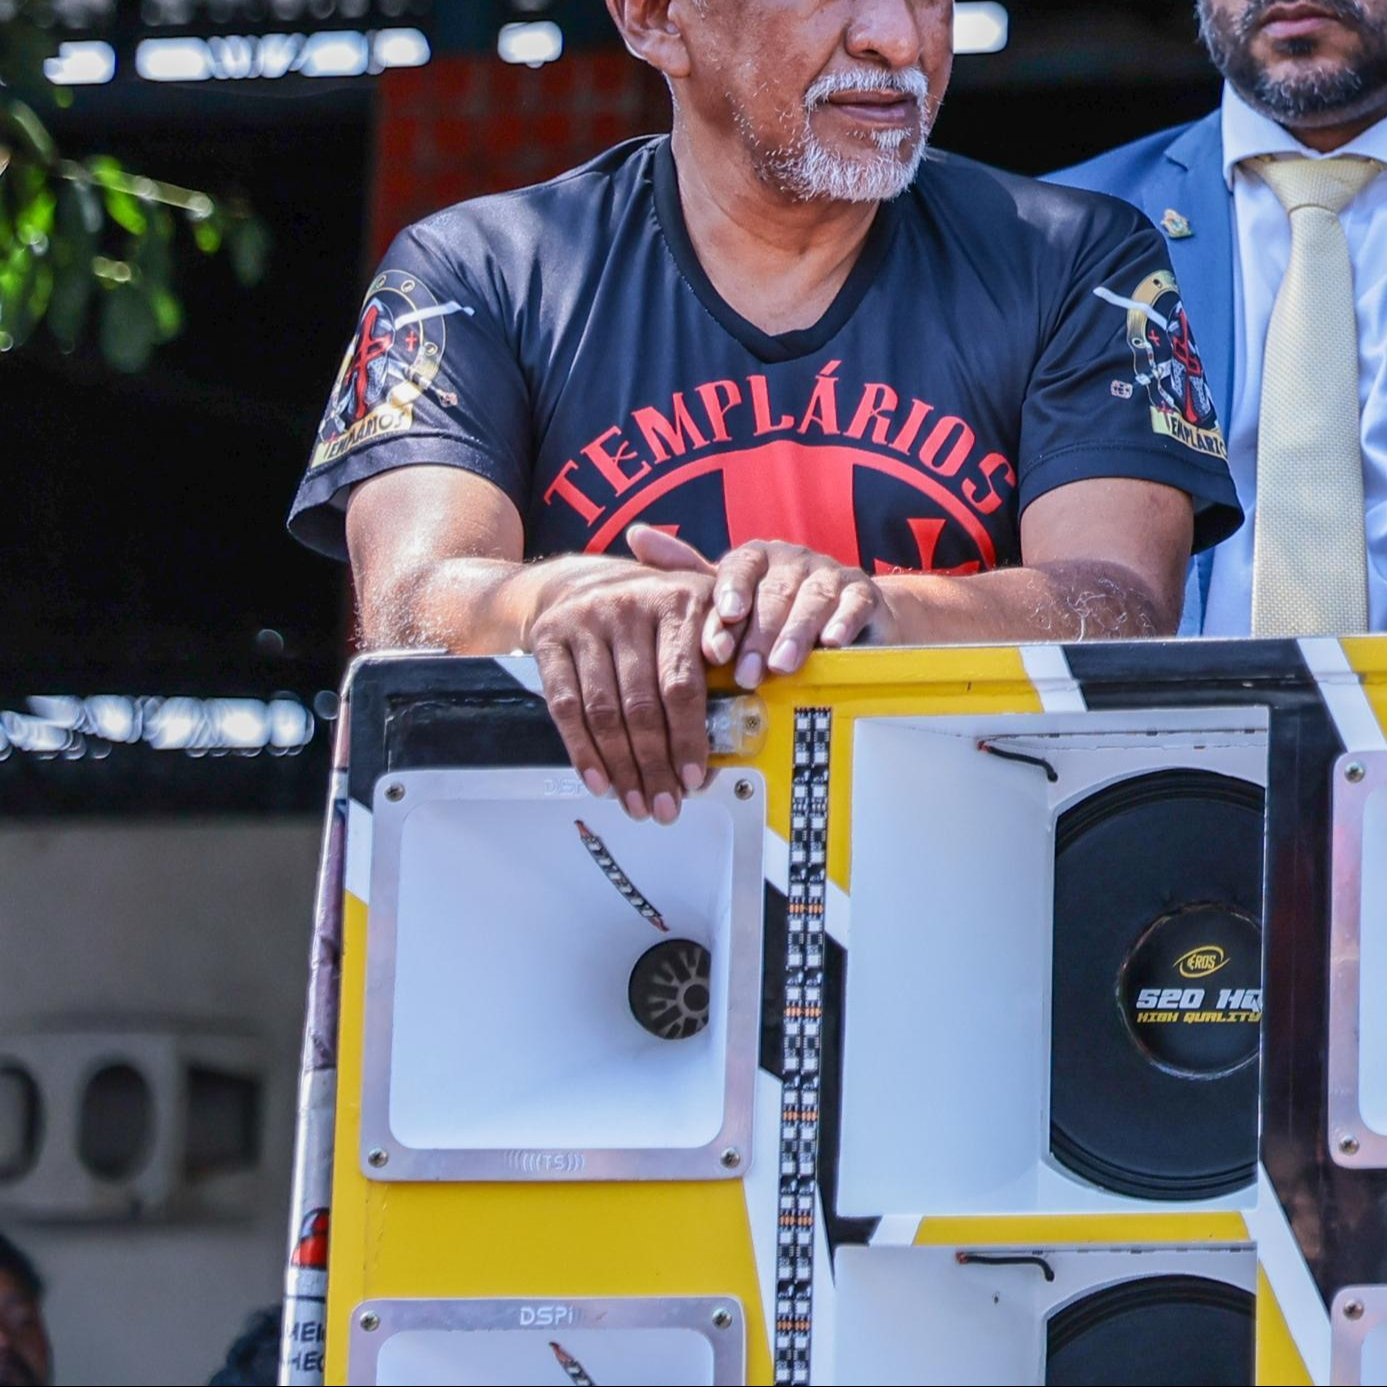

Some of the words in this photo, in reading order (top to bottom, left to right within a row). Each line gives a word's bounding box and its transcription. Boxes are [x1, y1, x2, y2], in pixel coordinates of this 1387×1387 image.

[543, 359, 1017, 527] TEMPLÁRIOS
[1187, 954, 1217, 971] EROS
[1135, 988, 1206, 1010] 520
[1215, 988, 1263, 1013] HQ
[1136, 1011, 1180, 1023] HIGH
[1183, 1011, 1263, 1024] QUALITY
